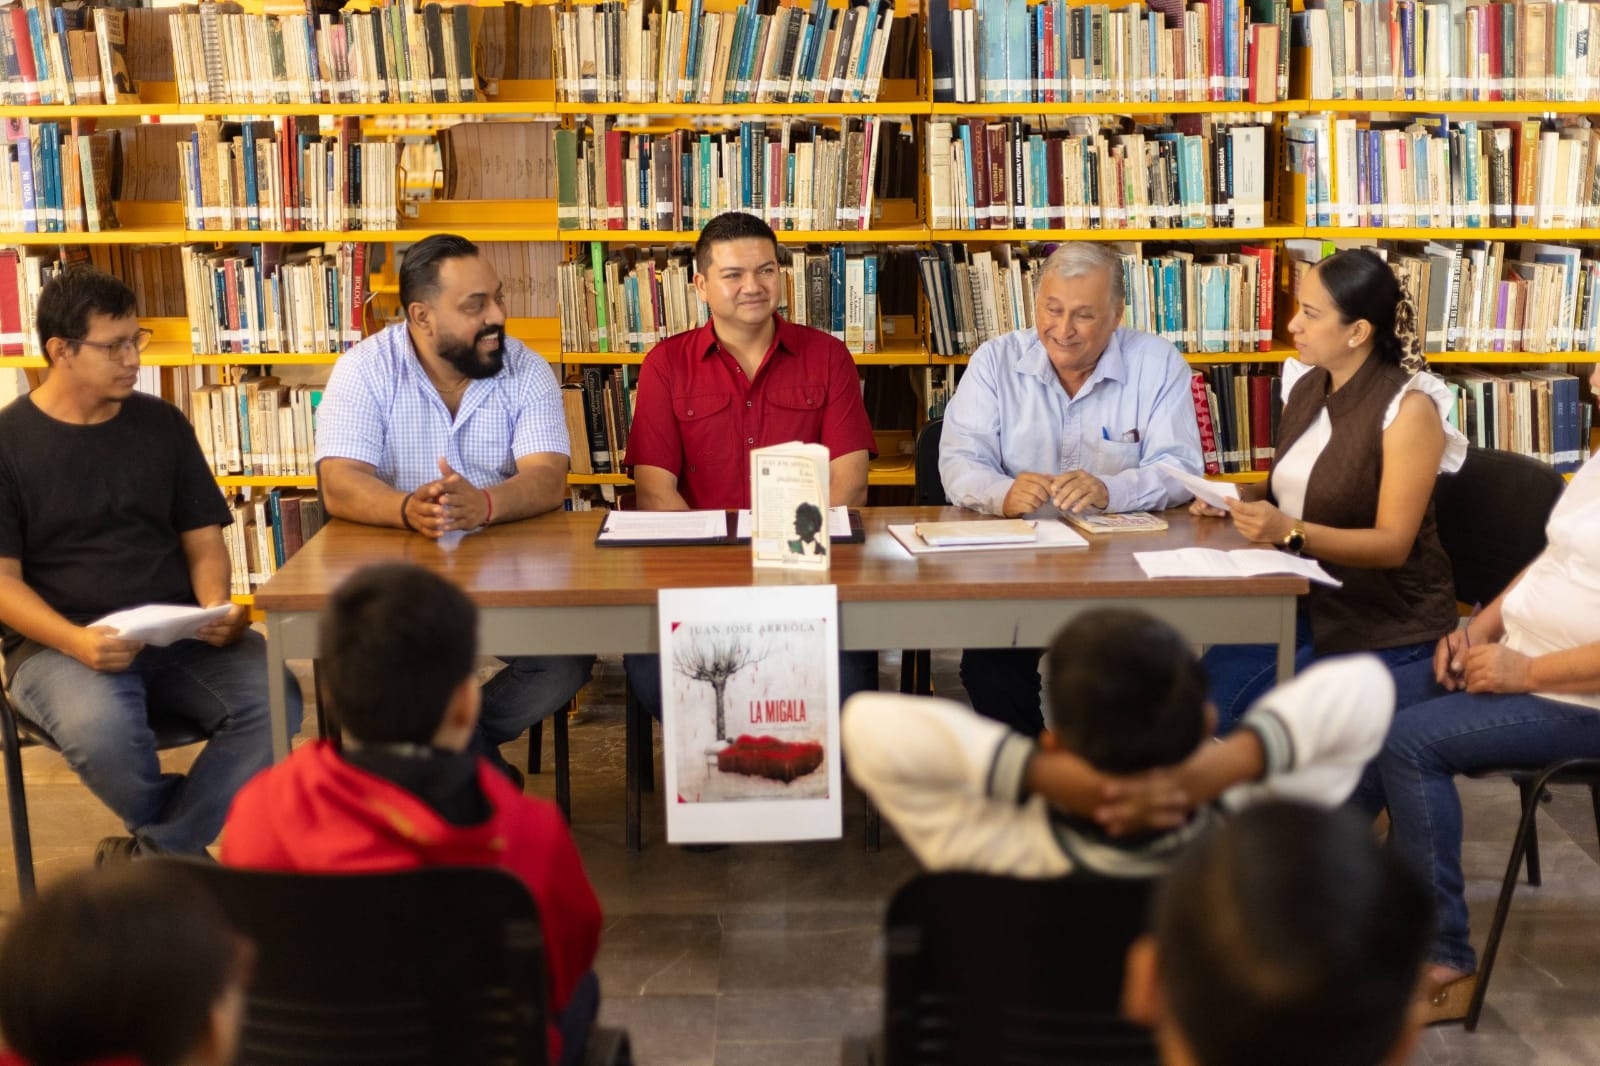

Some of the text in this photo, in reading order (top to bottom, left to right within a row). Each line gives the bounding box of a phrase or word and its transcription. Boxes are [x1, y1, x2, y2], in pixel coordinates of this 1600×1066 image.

[23, 183, 32, 202] IDEA
[690, 623, 815, 636] JUAN JOSÉ ARREOLA
[750, 699, 807, 724] LA MIGALA
